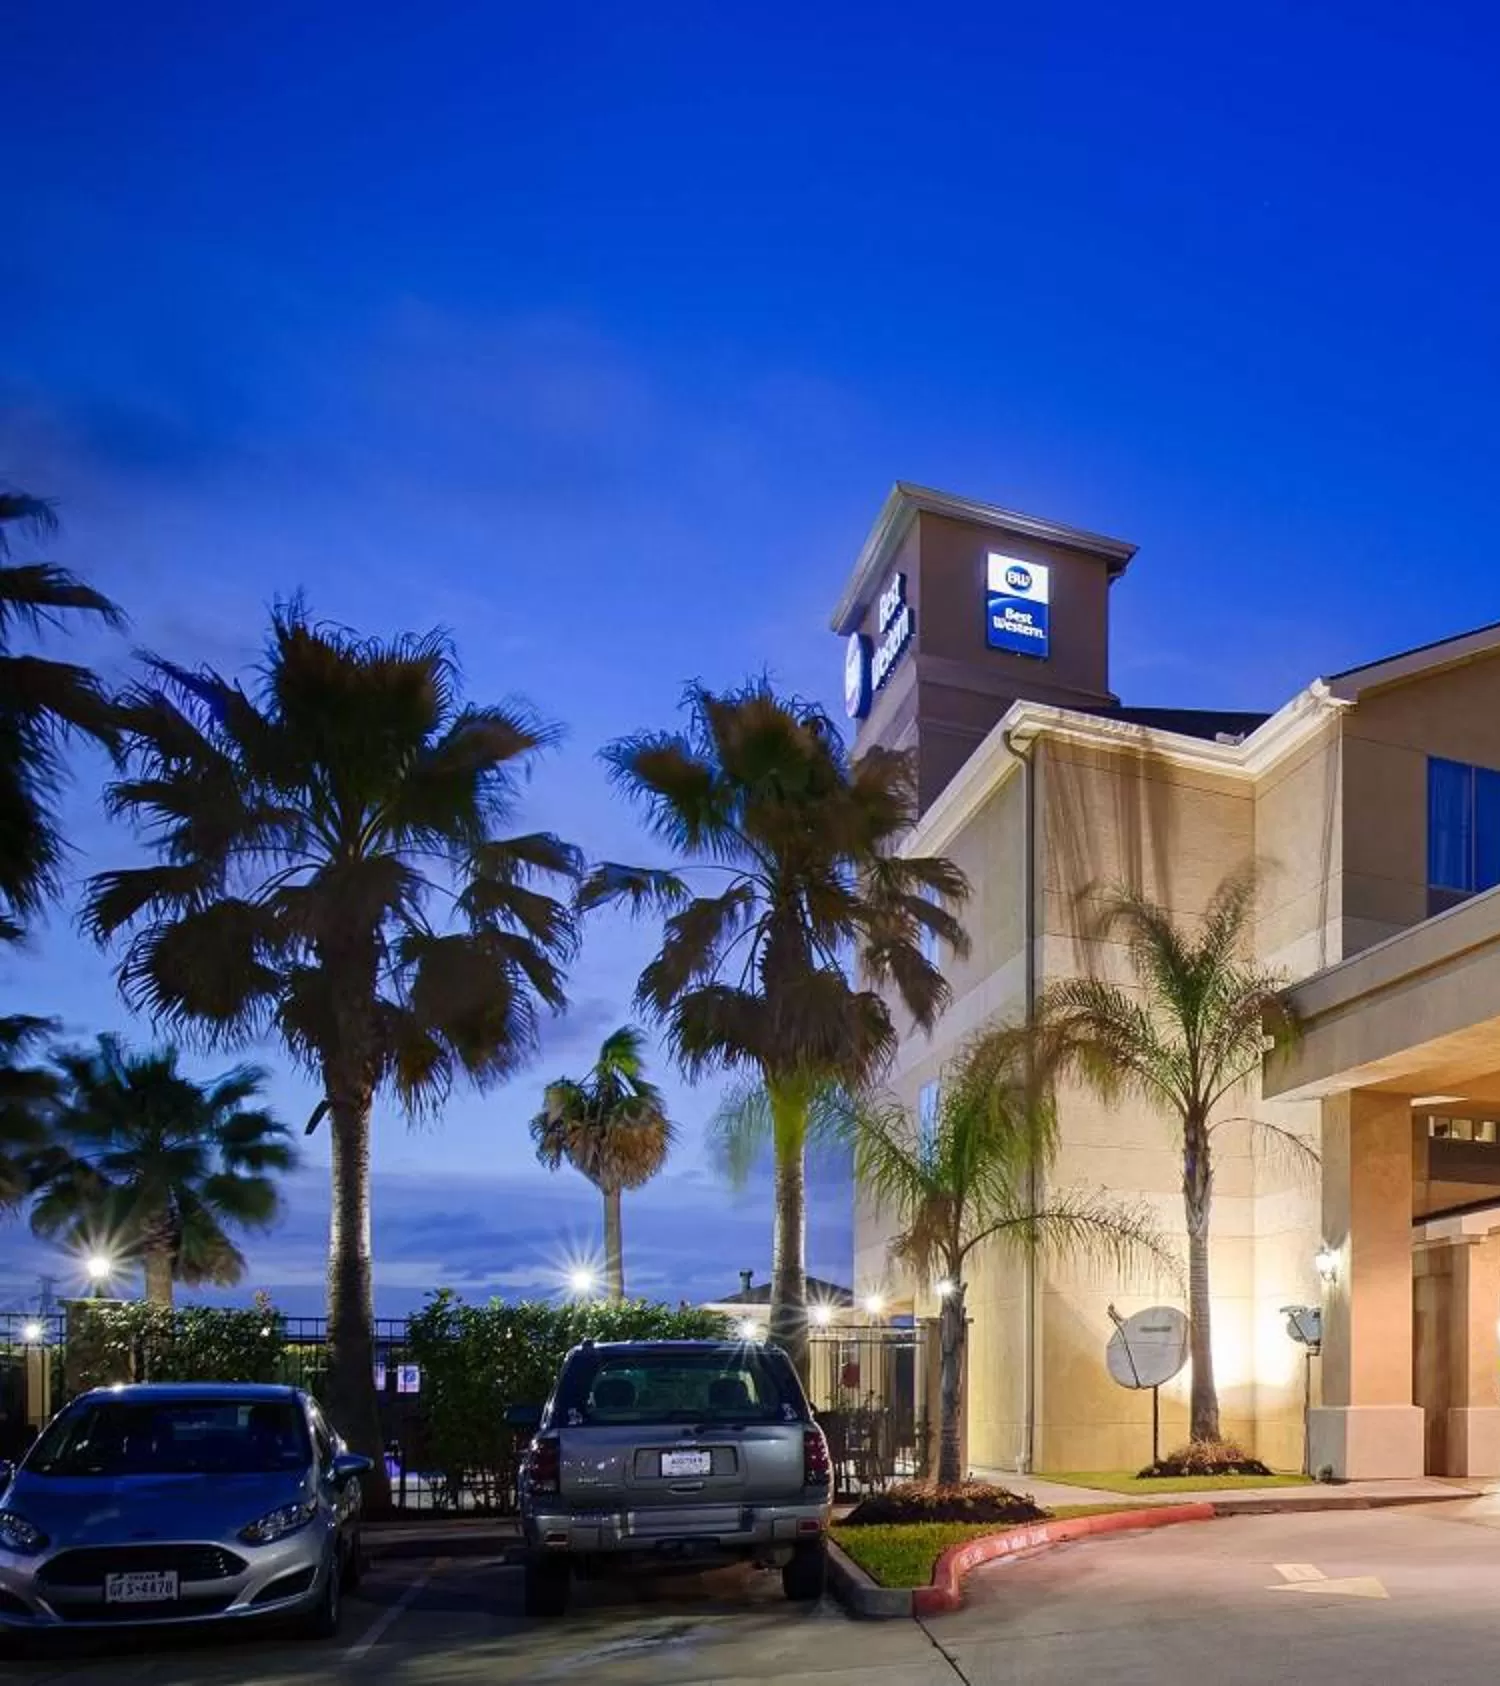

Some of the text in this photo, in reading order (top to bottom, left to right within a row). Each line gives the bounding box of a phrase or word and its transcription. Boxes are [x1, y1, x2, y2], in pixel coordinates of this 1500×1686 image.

[1006, 571, 1031, 588] BW
[1005, 607, 1033, 625] Best
[993, 615, 1045, 638] Western
